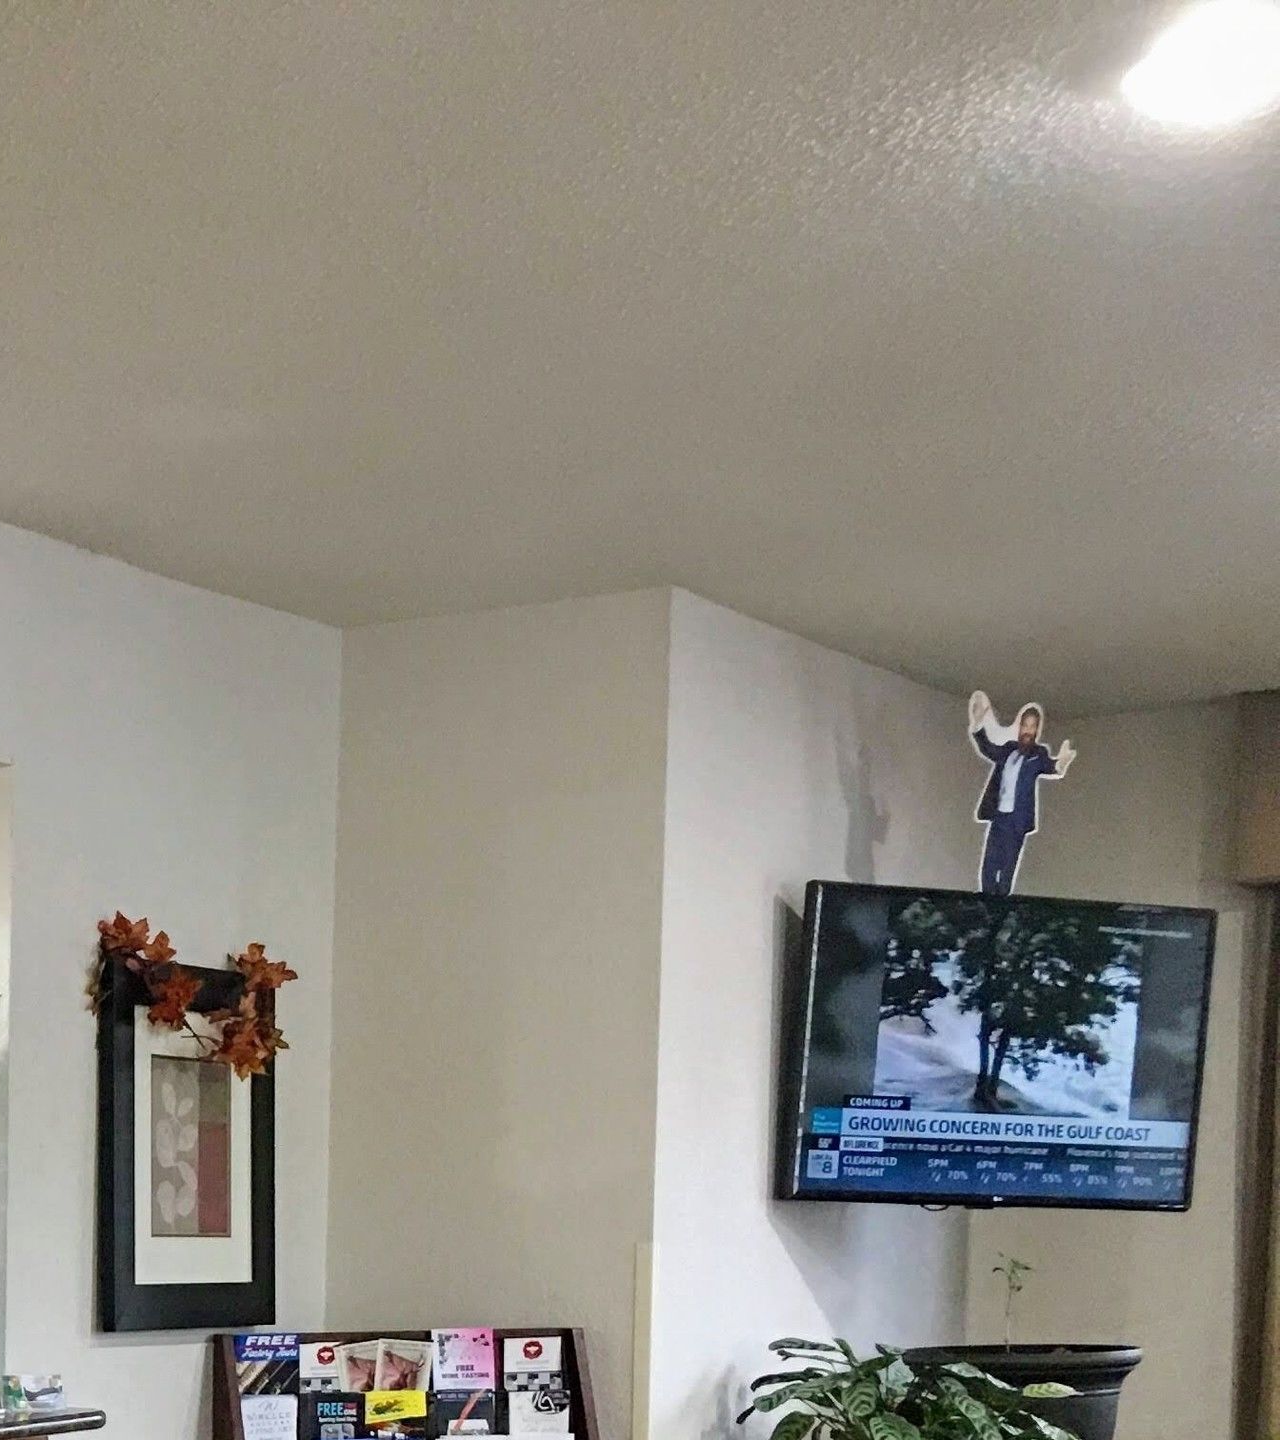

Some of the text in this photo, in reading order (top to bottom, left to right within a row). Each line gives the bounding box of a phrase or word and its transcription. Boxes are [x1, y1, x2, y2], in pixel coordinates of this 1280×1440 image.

[850, 1097, 903, 1108] COMING UP
[849, 1116, 926, 1132] GROWING
[929, 1119, 1001, 1135] CONCERN
[1005, 1123, 1034, 1136] FOR
[1038, 1124, 1063, 1138] THE
[1067, 1125, 1103, 1139] GULF
[1106, 1127, 1151, 1141] COAST
[843, 1156, 897, 1166] CLEARFIELD
[928, 1158, 948, 1167] 5PM
[843, 1167, 885, 1176] TONIGHT
[246, 1335, 297, 1345] FREE
[317, 1402, 343, 1416] FREE
